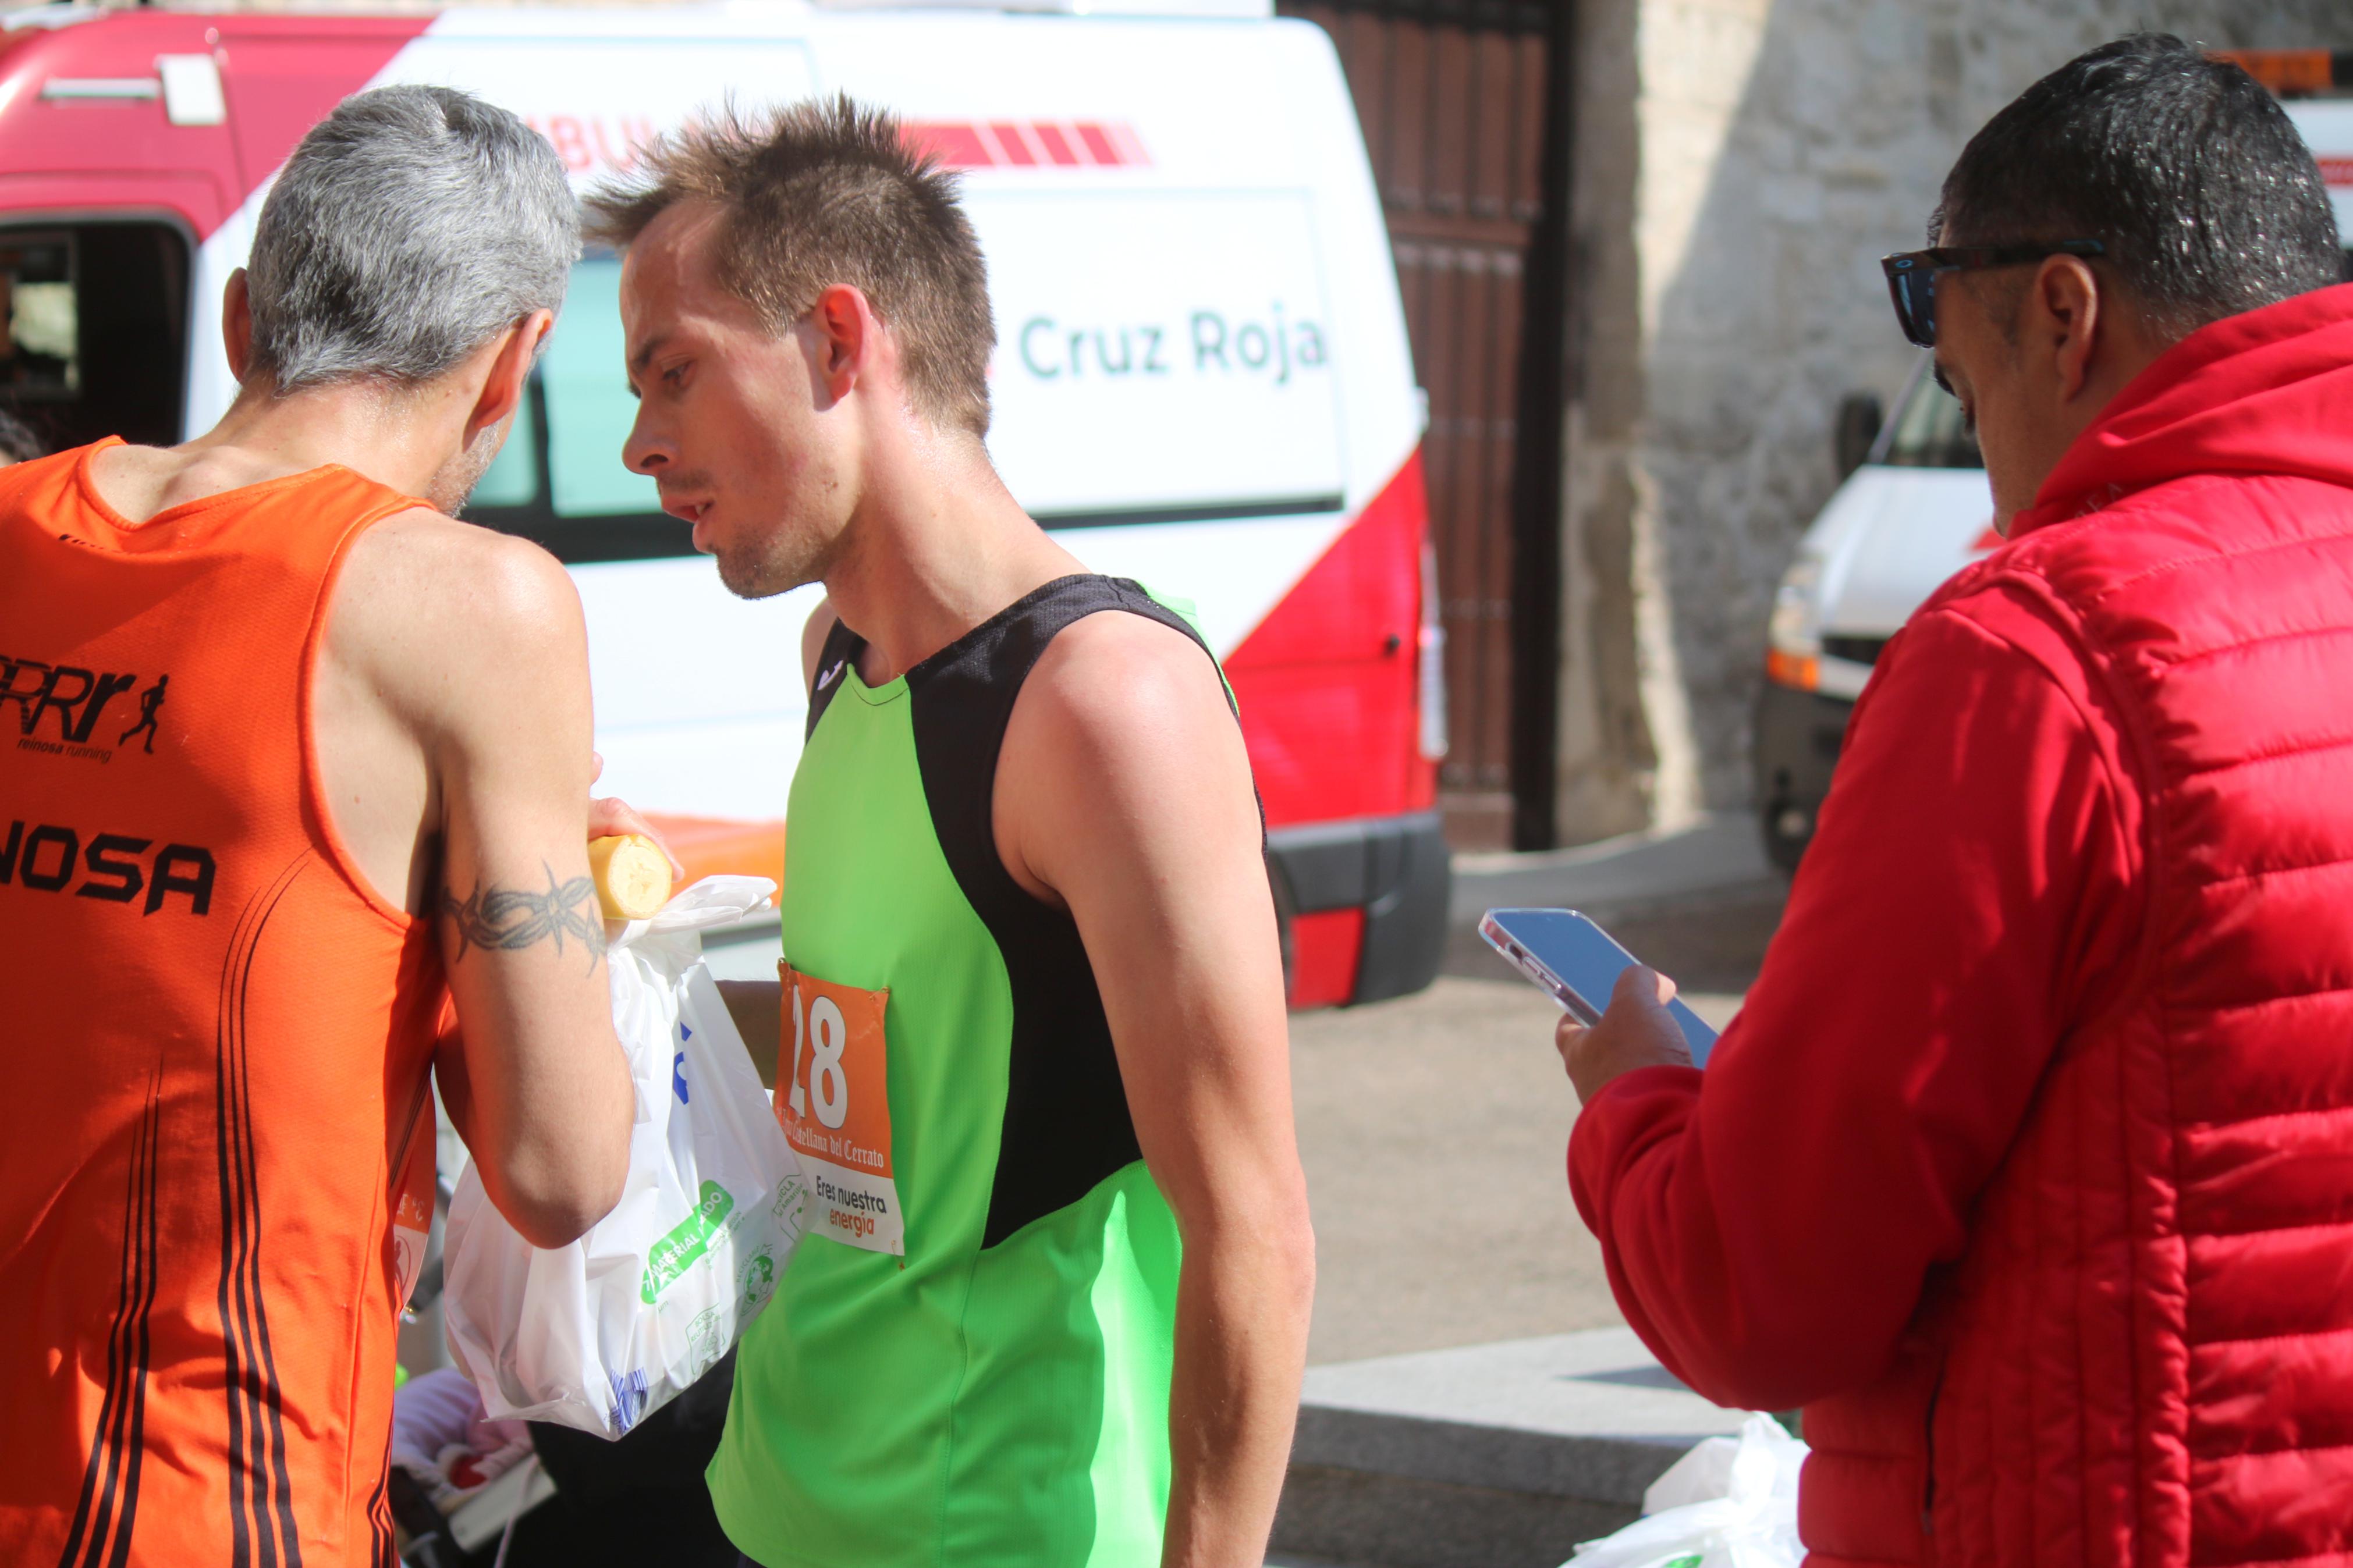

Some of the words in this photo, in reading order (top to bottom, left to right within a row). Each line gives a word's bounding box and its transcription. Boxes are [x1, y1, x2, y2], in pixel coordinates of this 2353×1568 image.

[1018, 315, 1169, 380] Cruz
[1190, 300, 1328, 386] Roja
[17, 737, 64, 755] reinosa
[66, 744, 112, 764] running
[829, 1134, 842, 1157] del
[844, 1139, 884, 1168] Cerrato
[816, 1175, 836, 1201] Eres
[838, 1183, 887, 1214] nuestra
[829, 1207, 874, 1238] energía
